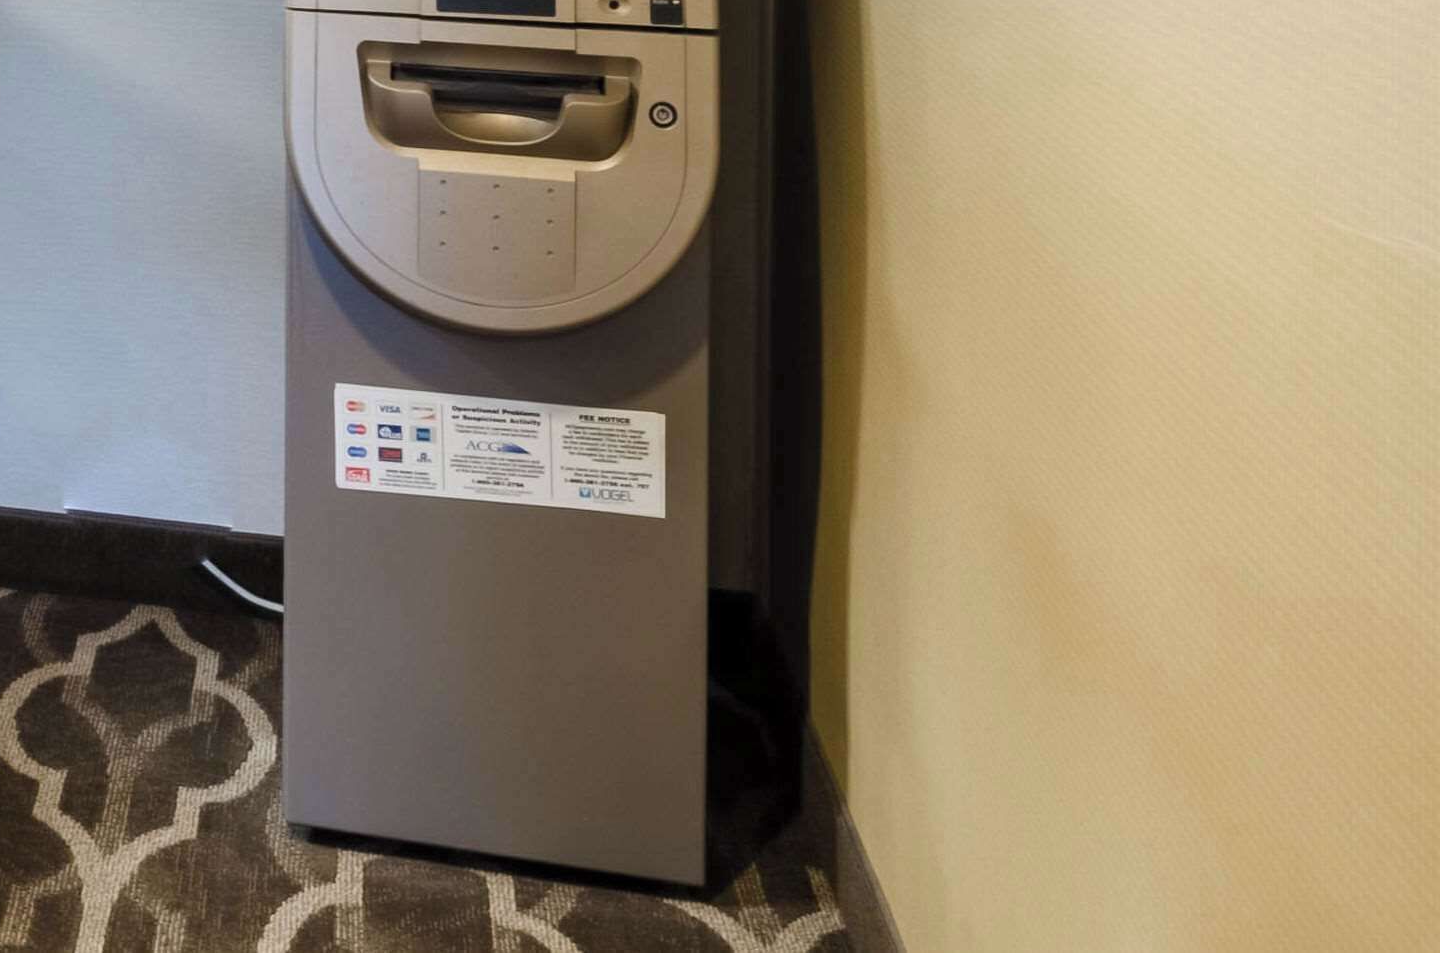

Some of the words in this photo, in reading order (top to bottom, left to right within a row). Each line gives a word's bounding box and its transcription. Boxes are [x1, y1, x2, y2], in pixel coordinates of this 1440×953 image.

[379, 405, 402, 414] VISA
[451, 405, 500, 414] Operational
[501, 409, 541, 418] Problems
[509, 418, 541, 427] Activity
[597, 415, 631, 424] NOTICE
